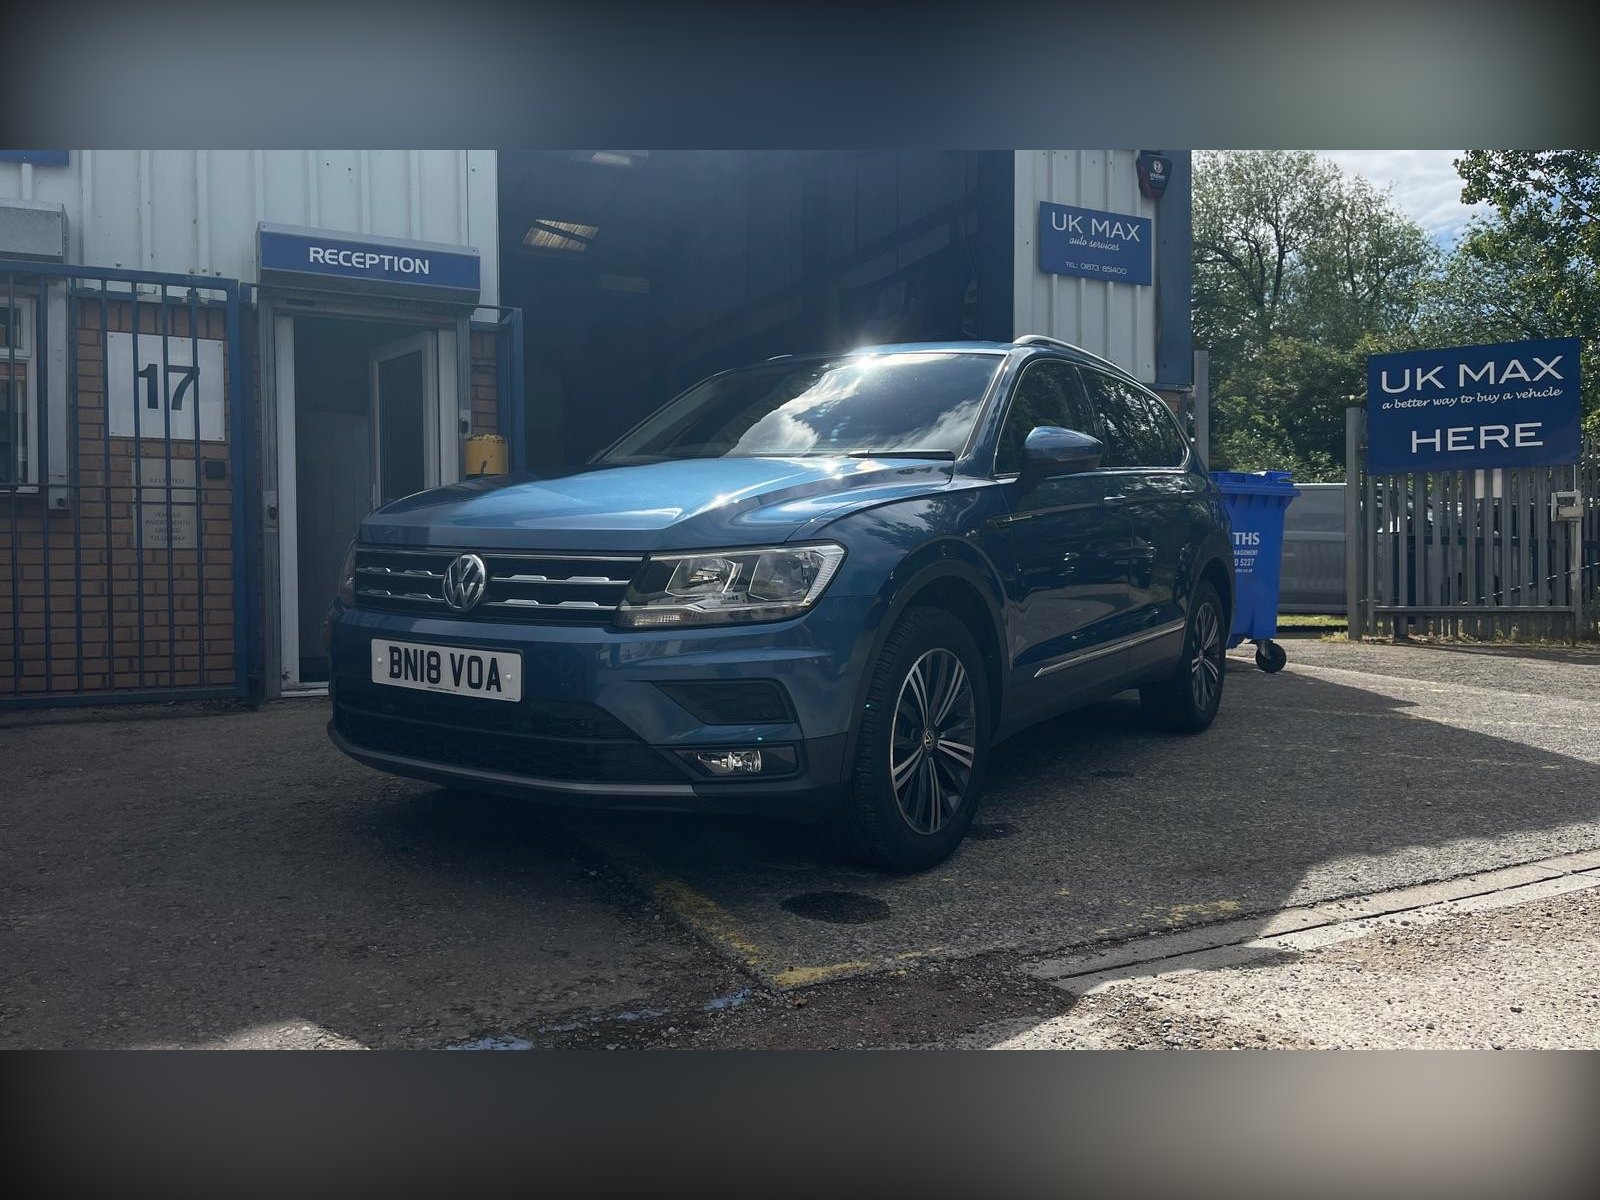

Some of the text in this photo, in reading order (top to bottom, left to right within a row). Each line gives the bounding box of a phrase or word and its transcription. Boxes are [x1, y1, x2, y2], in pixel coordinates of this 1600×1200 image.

[1051, 211, 1140, 242] UK MAX
[1068, 235, 1120, 251] auto services
[309, 246, 430, 276] RECEPTION
[136, 363, 200, 411] 17
[1381, 355, 1564, 394] UK MAX
[1382, 387, 1564, 410] a better way to buy a vehicle
[1411, 422, 1544, 454] HERE
[388, 646, 502, 693] BN18 VOA
